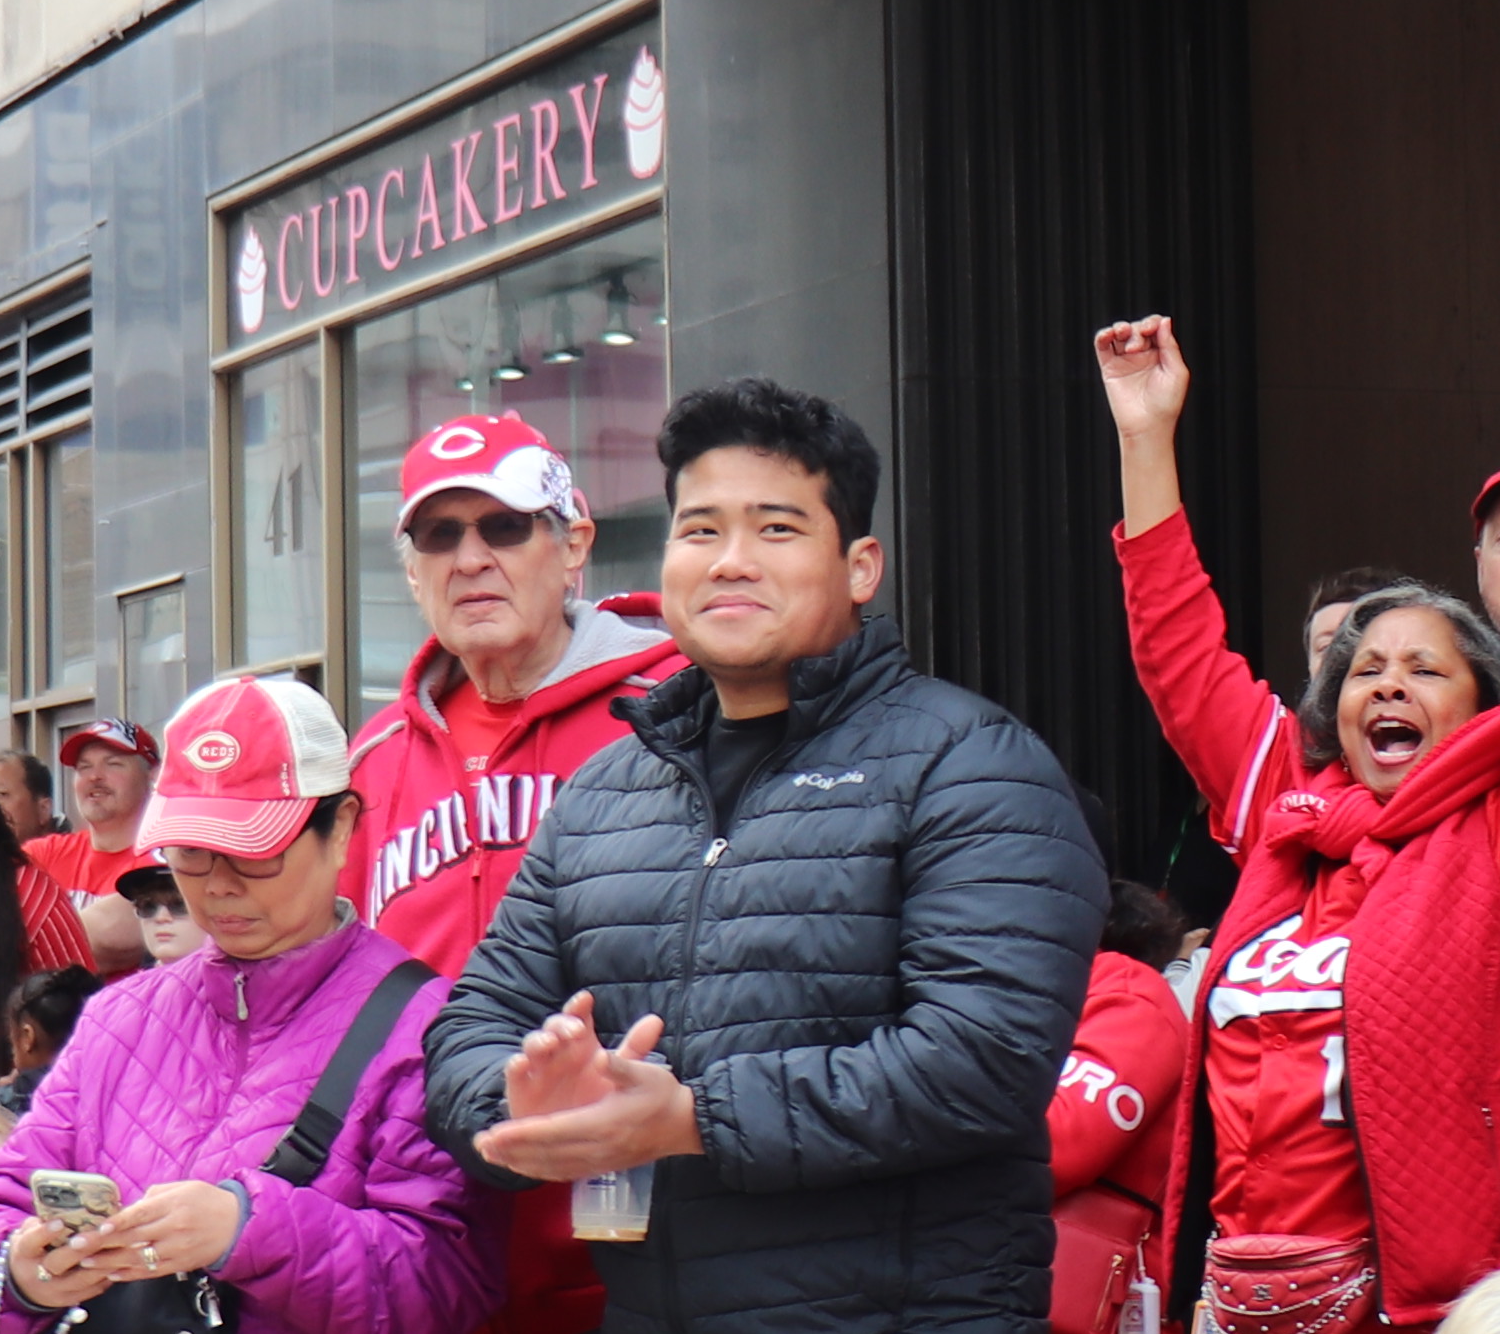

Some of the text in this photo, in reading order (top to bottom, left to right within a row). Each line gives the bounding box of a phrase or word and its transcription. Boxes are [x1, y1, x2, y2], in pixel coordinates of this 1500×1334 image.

[275, 73, 609, 311] CUPCAKERY
[264, 463, 304, 556] 41
[201, 746, 235, 758] REDS
